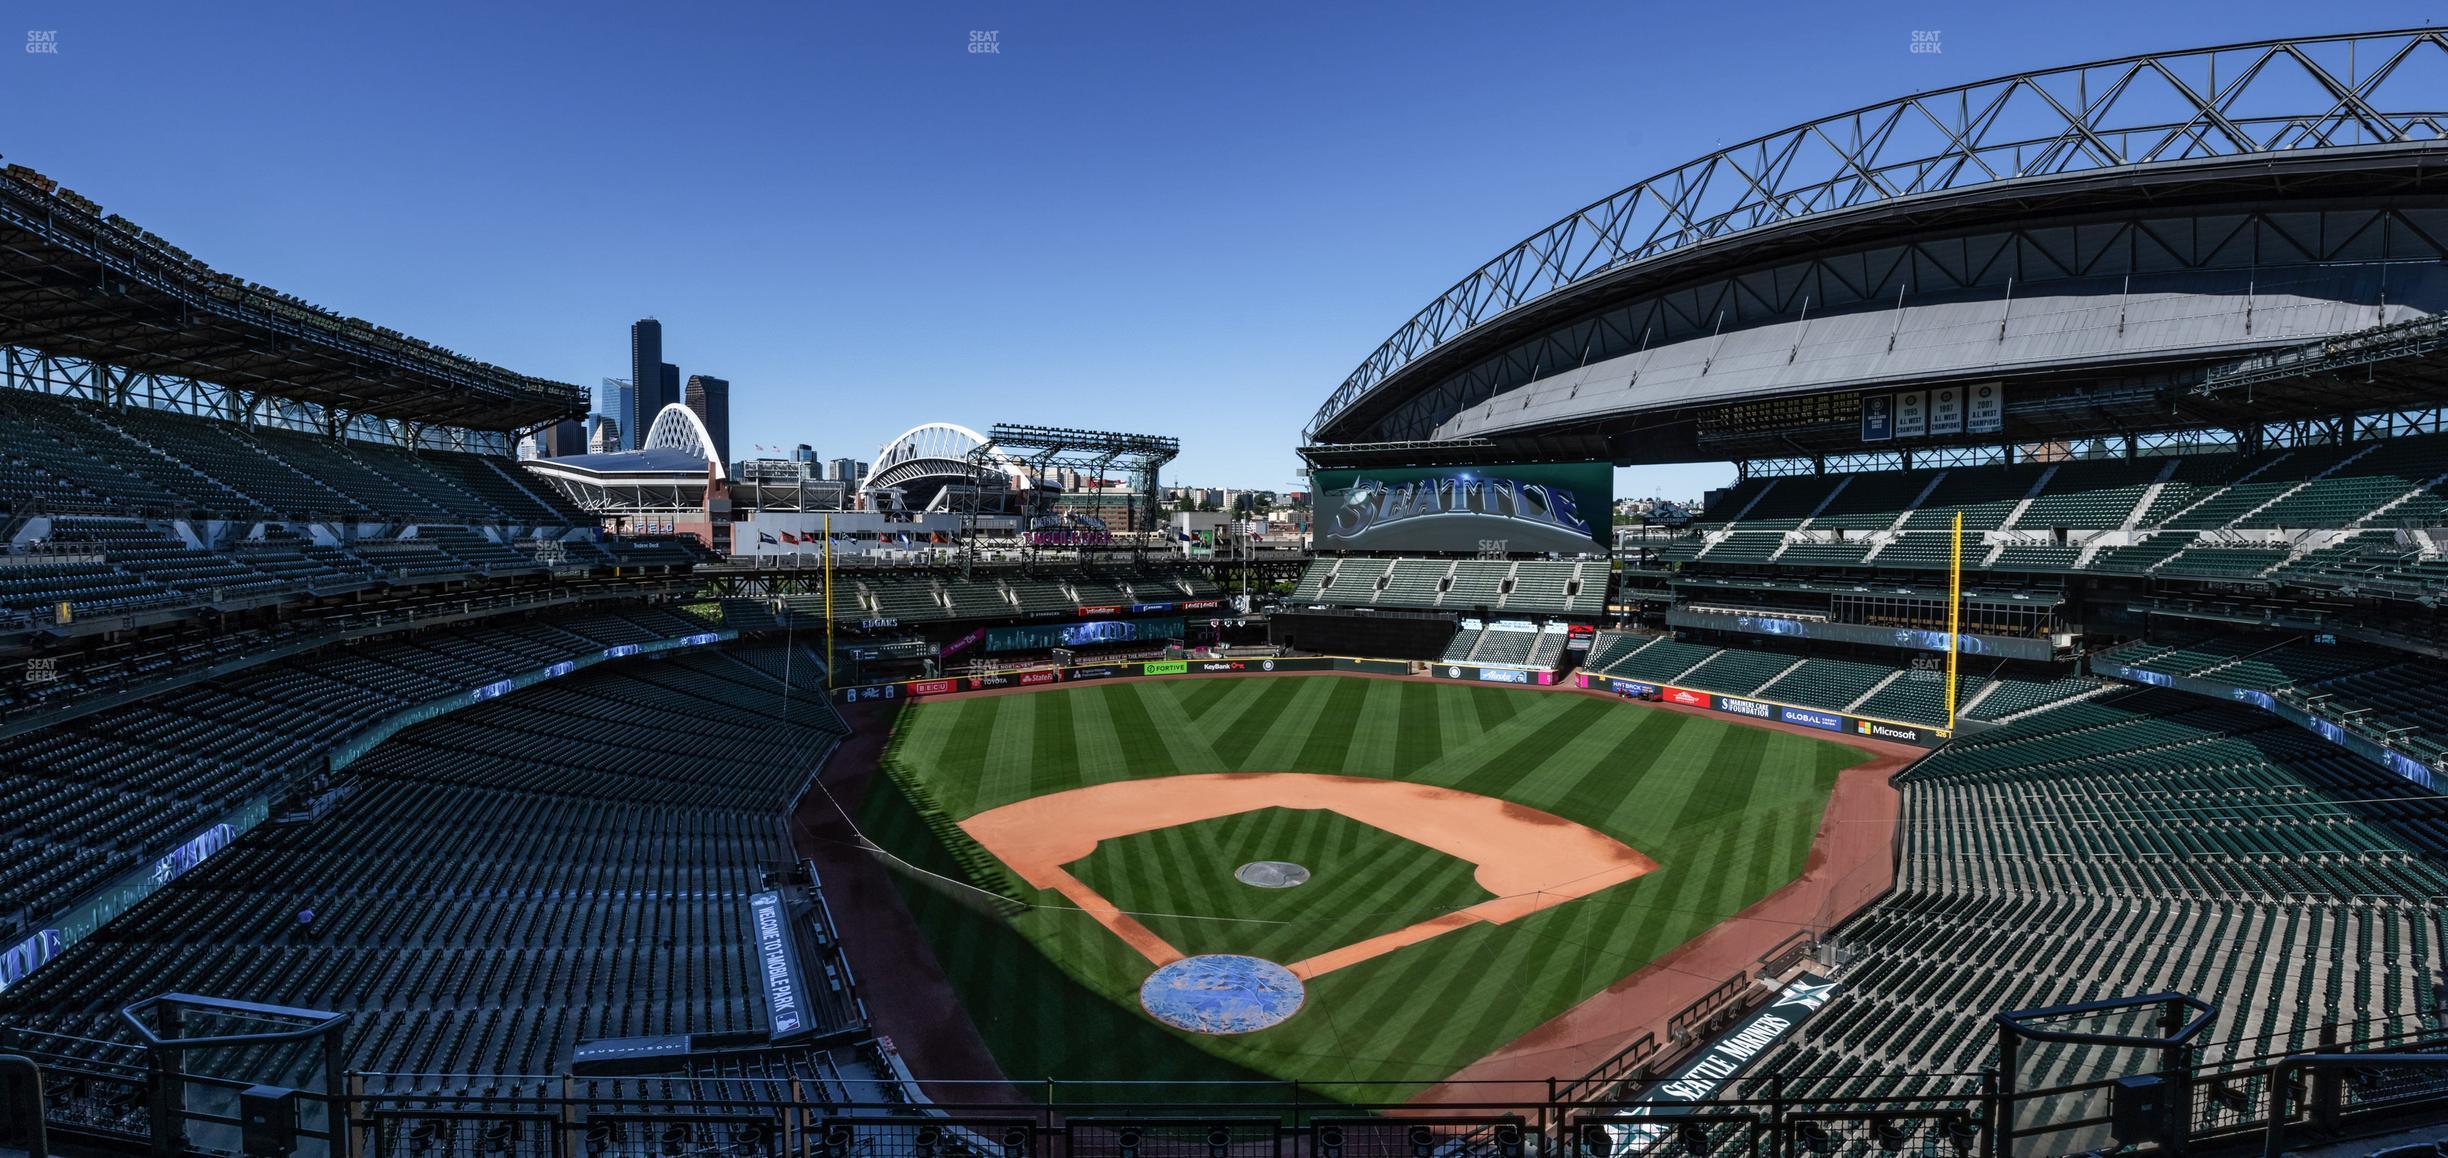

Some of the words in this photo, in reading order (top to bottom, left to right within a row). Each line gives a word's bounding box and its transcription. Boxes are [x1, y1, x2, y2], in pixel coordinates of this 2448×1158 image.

[1978, 400, 1992, 408] 2001
[1931, 422, 1960, 430] CHAMPIONS
[1327, 475, 1593, 539] SEATTLE
[1080, 530, 1111, 545] PARK
[1156, 664, 1184, 672] FORTIVE
[920, 684, 946, 692] BECU
[1730, 699, 1755, 708] MARINERS
[1730, 705, 1769, 717] FOUNDATION
[1786, 712, 1820, 724] GLOBAL
[1873, 725, 1916, 740] Microsoft
[759, 906, 780, 940] WELCOME
[764, 938, 782, 951] TO
[772, 982, 795, 1012] PARK
[1662, 1054, 1738, 1102] SEATTLE
[1714, 1013, 1792, 1062] MARINERS
